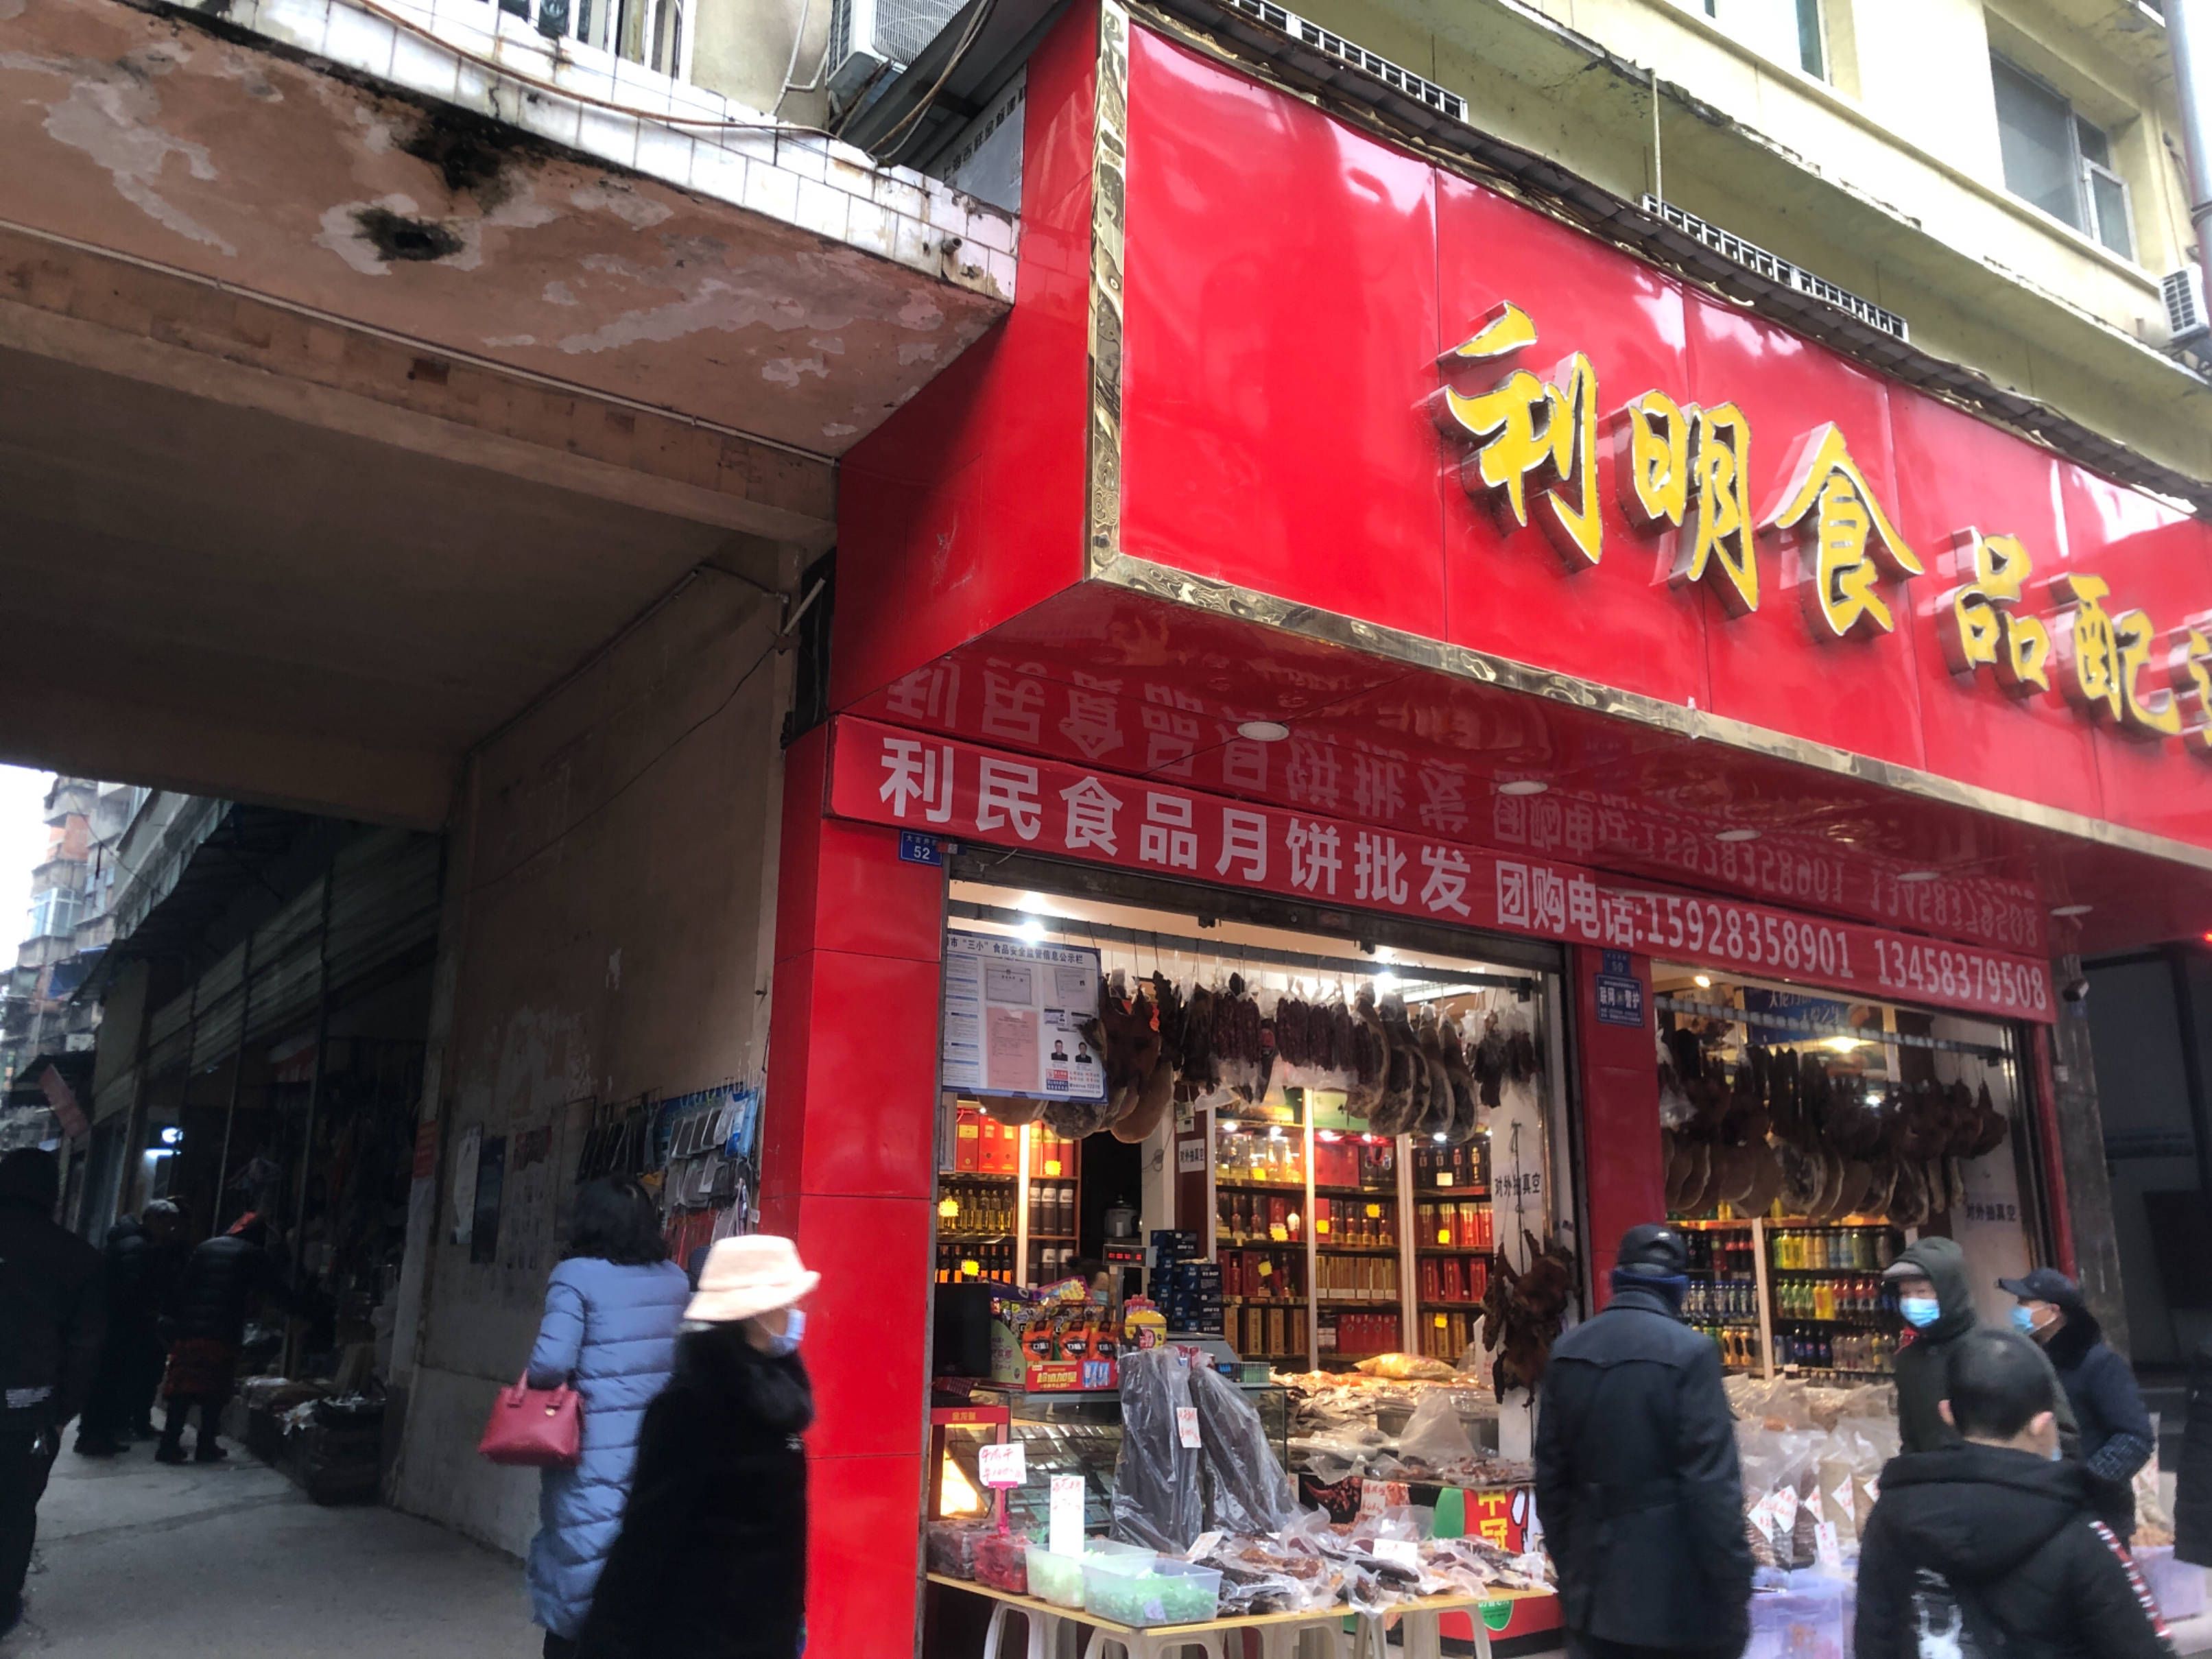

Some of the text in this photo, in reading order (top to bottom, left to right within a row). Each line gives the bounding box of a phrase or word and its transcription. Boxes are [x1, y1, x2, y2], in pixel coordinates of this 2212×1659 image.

[914, 845, 930, 860] 52
[879, 737, 1473, 917] 利民食品月饼批发
[1875, 938, 2047, 1012] 13458379508
[947, 936, 1084, 964] 市“三小”食品安全监管信息公示栏
